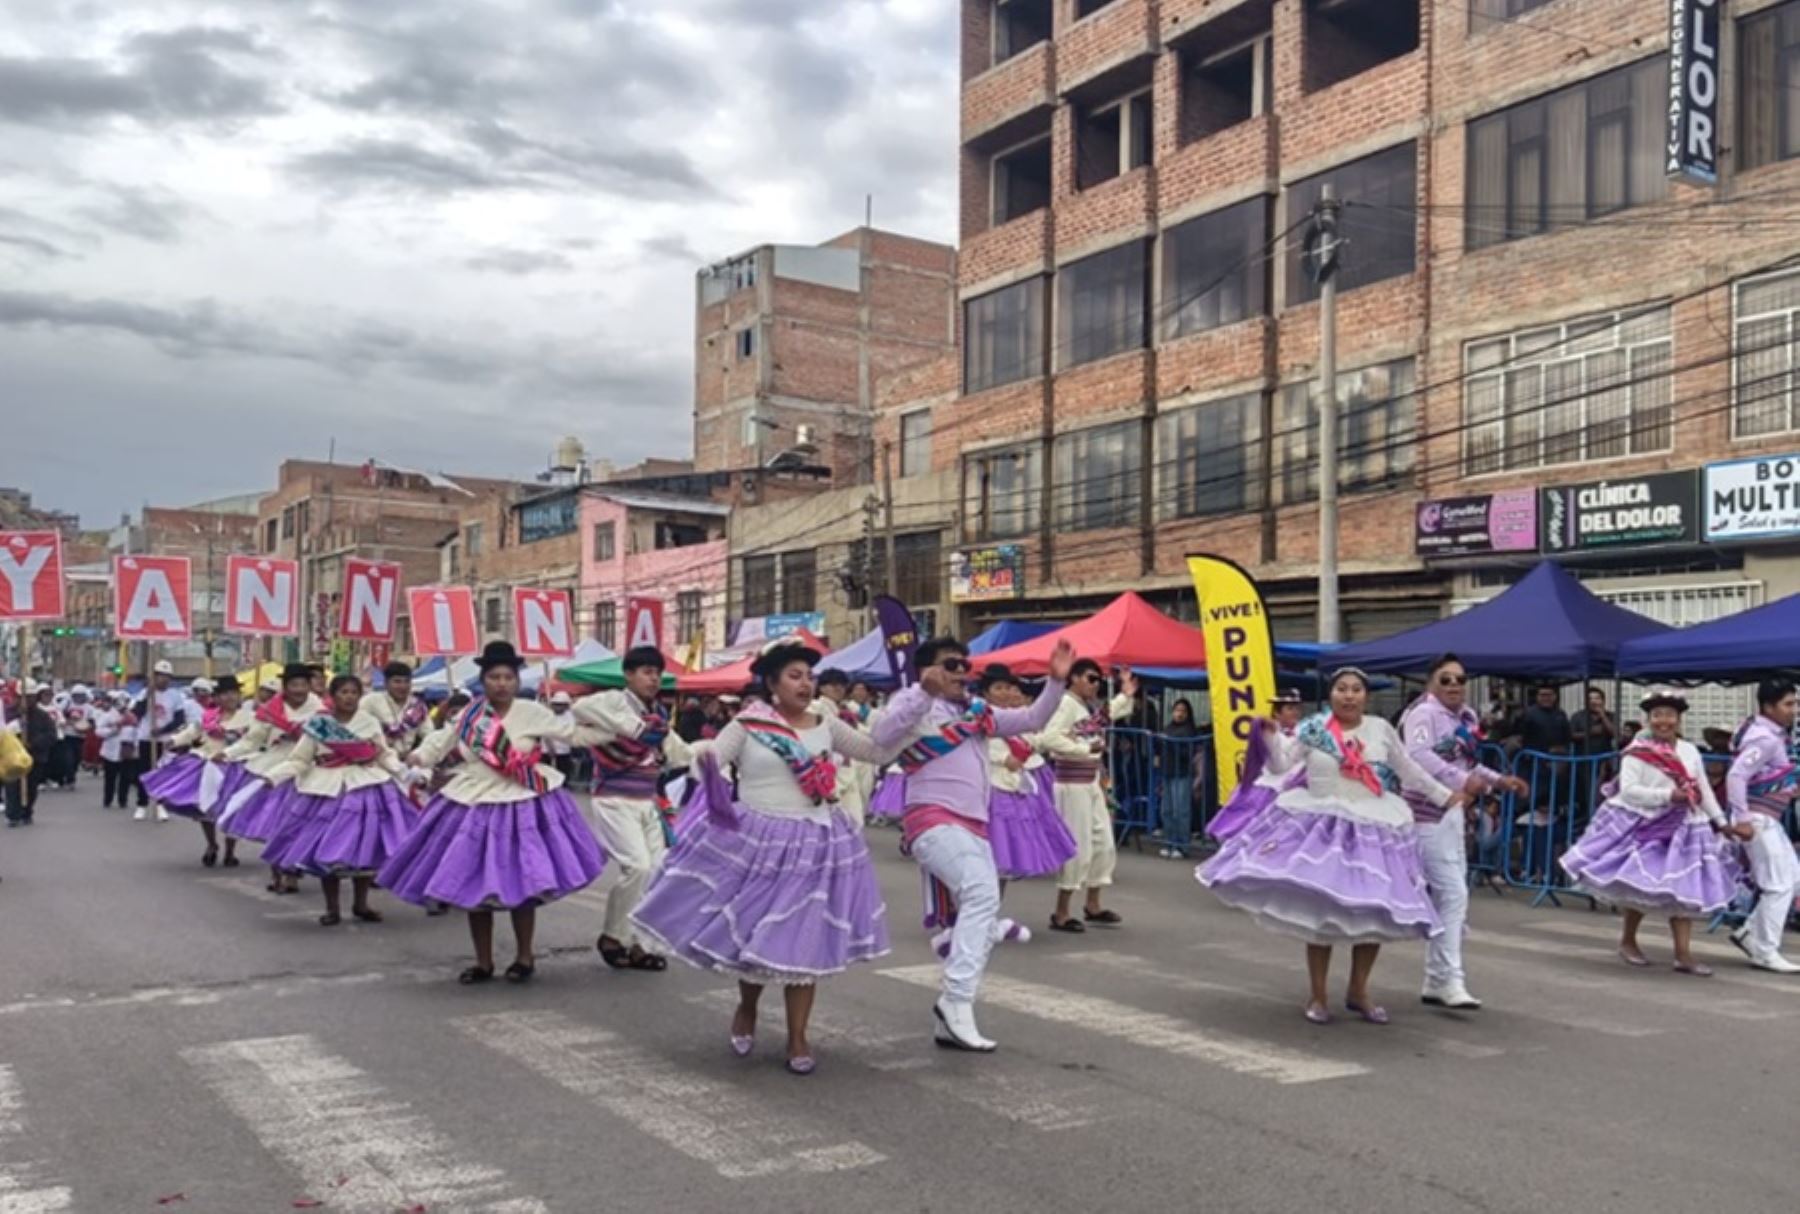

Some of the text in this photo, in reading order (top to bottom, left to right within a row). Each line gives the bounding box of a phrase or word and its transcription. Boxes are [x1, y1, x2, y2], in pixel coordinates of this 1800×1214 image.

[1688, 0, 1714, 161] LOR
[1578, 481, 1651, 509] CLÍNICA
[1756, 459, 1800, 481] BO
[1580, 504, 1682, 533] DEL DOLOR
[0, 546, 53, 611] Y
[123, 569, 185, 631] A
[236, 567, 290, 627] N
[348, 574, 393, 634] N
[1223, 626, 1256, 741] PUNO
